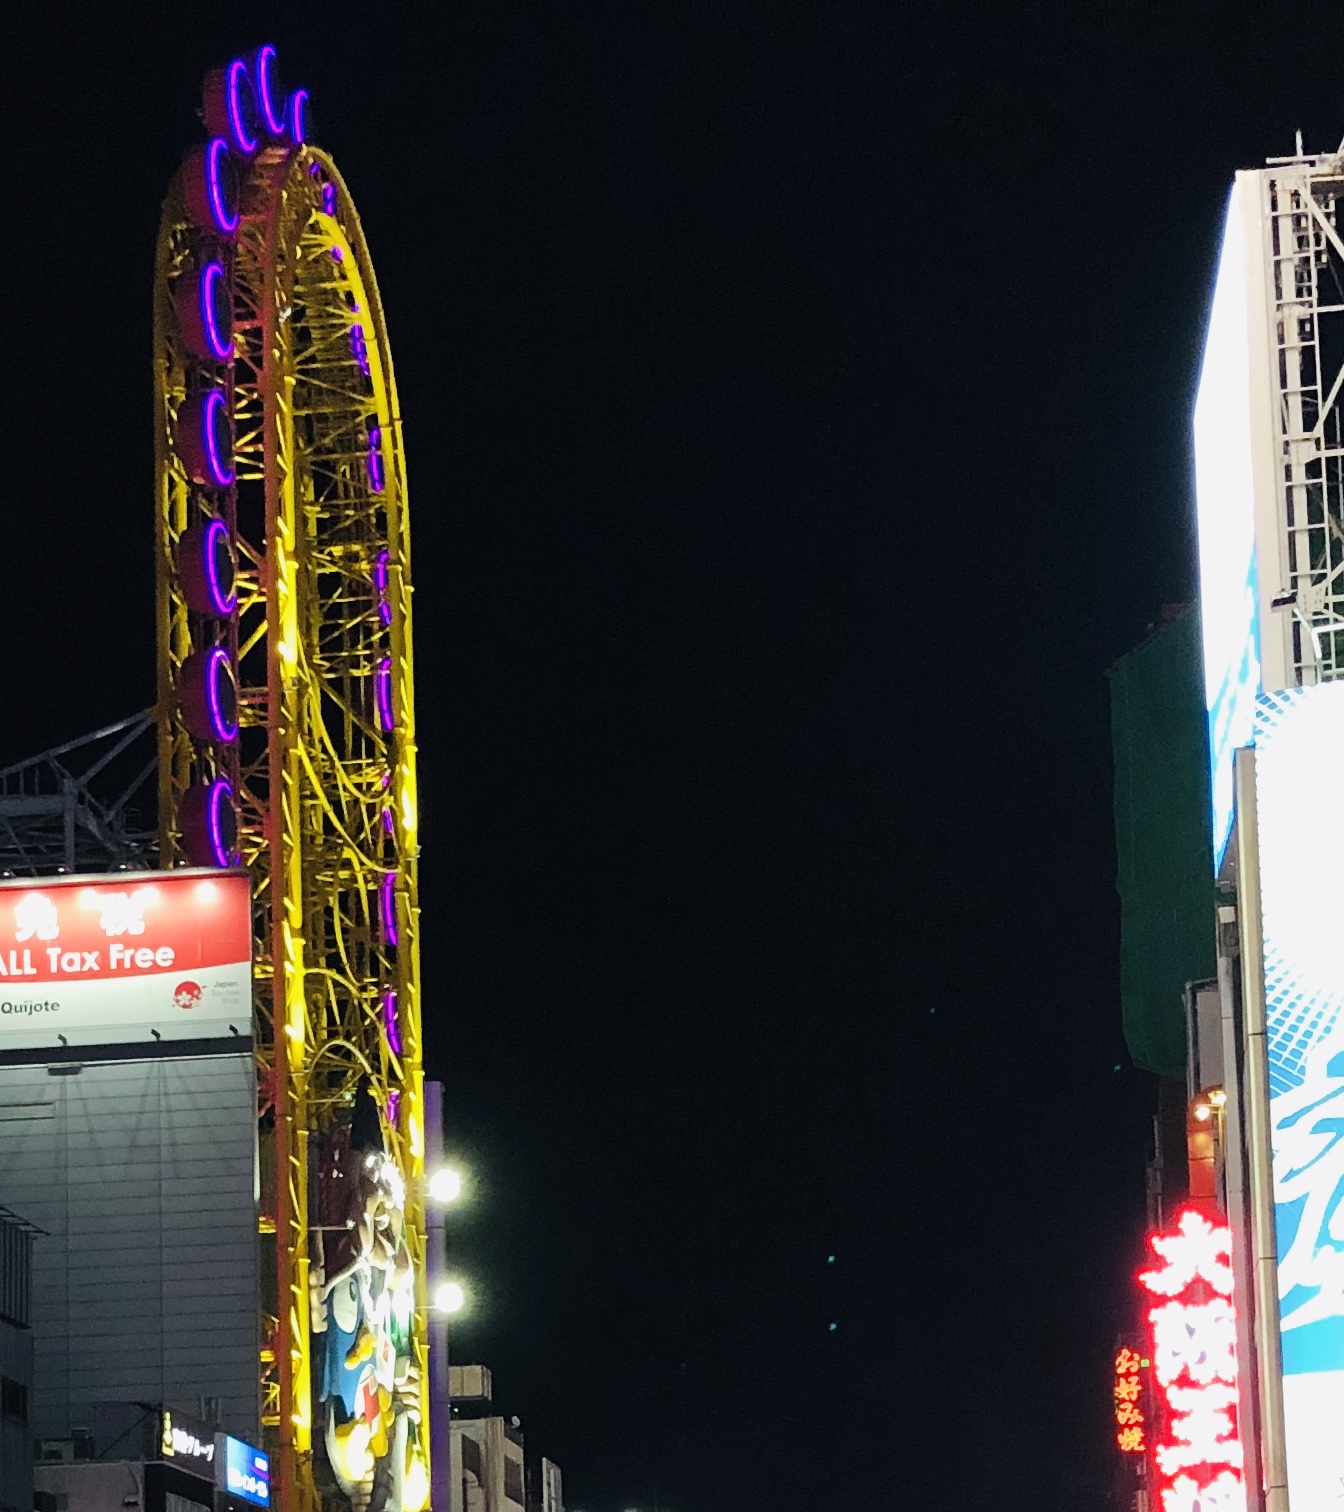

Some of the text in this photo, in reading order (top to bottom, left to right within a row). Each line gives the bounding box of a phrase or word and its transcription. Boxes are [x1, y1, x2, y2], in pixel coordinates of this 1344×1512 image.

[46, 947, 101, 973] Tax
[110, 944, 175, 970] Free
[1, 1000, 60, 1017] Quijote
[1114, 1348, 1146, 1452] お好み焼
